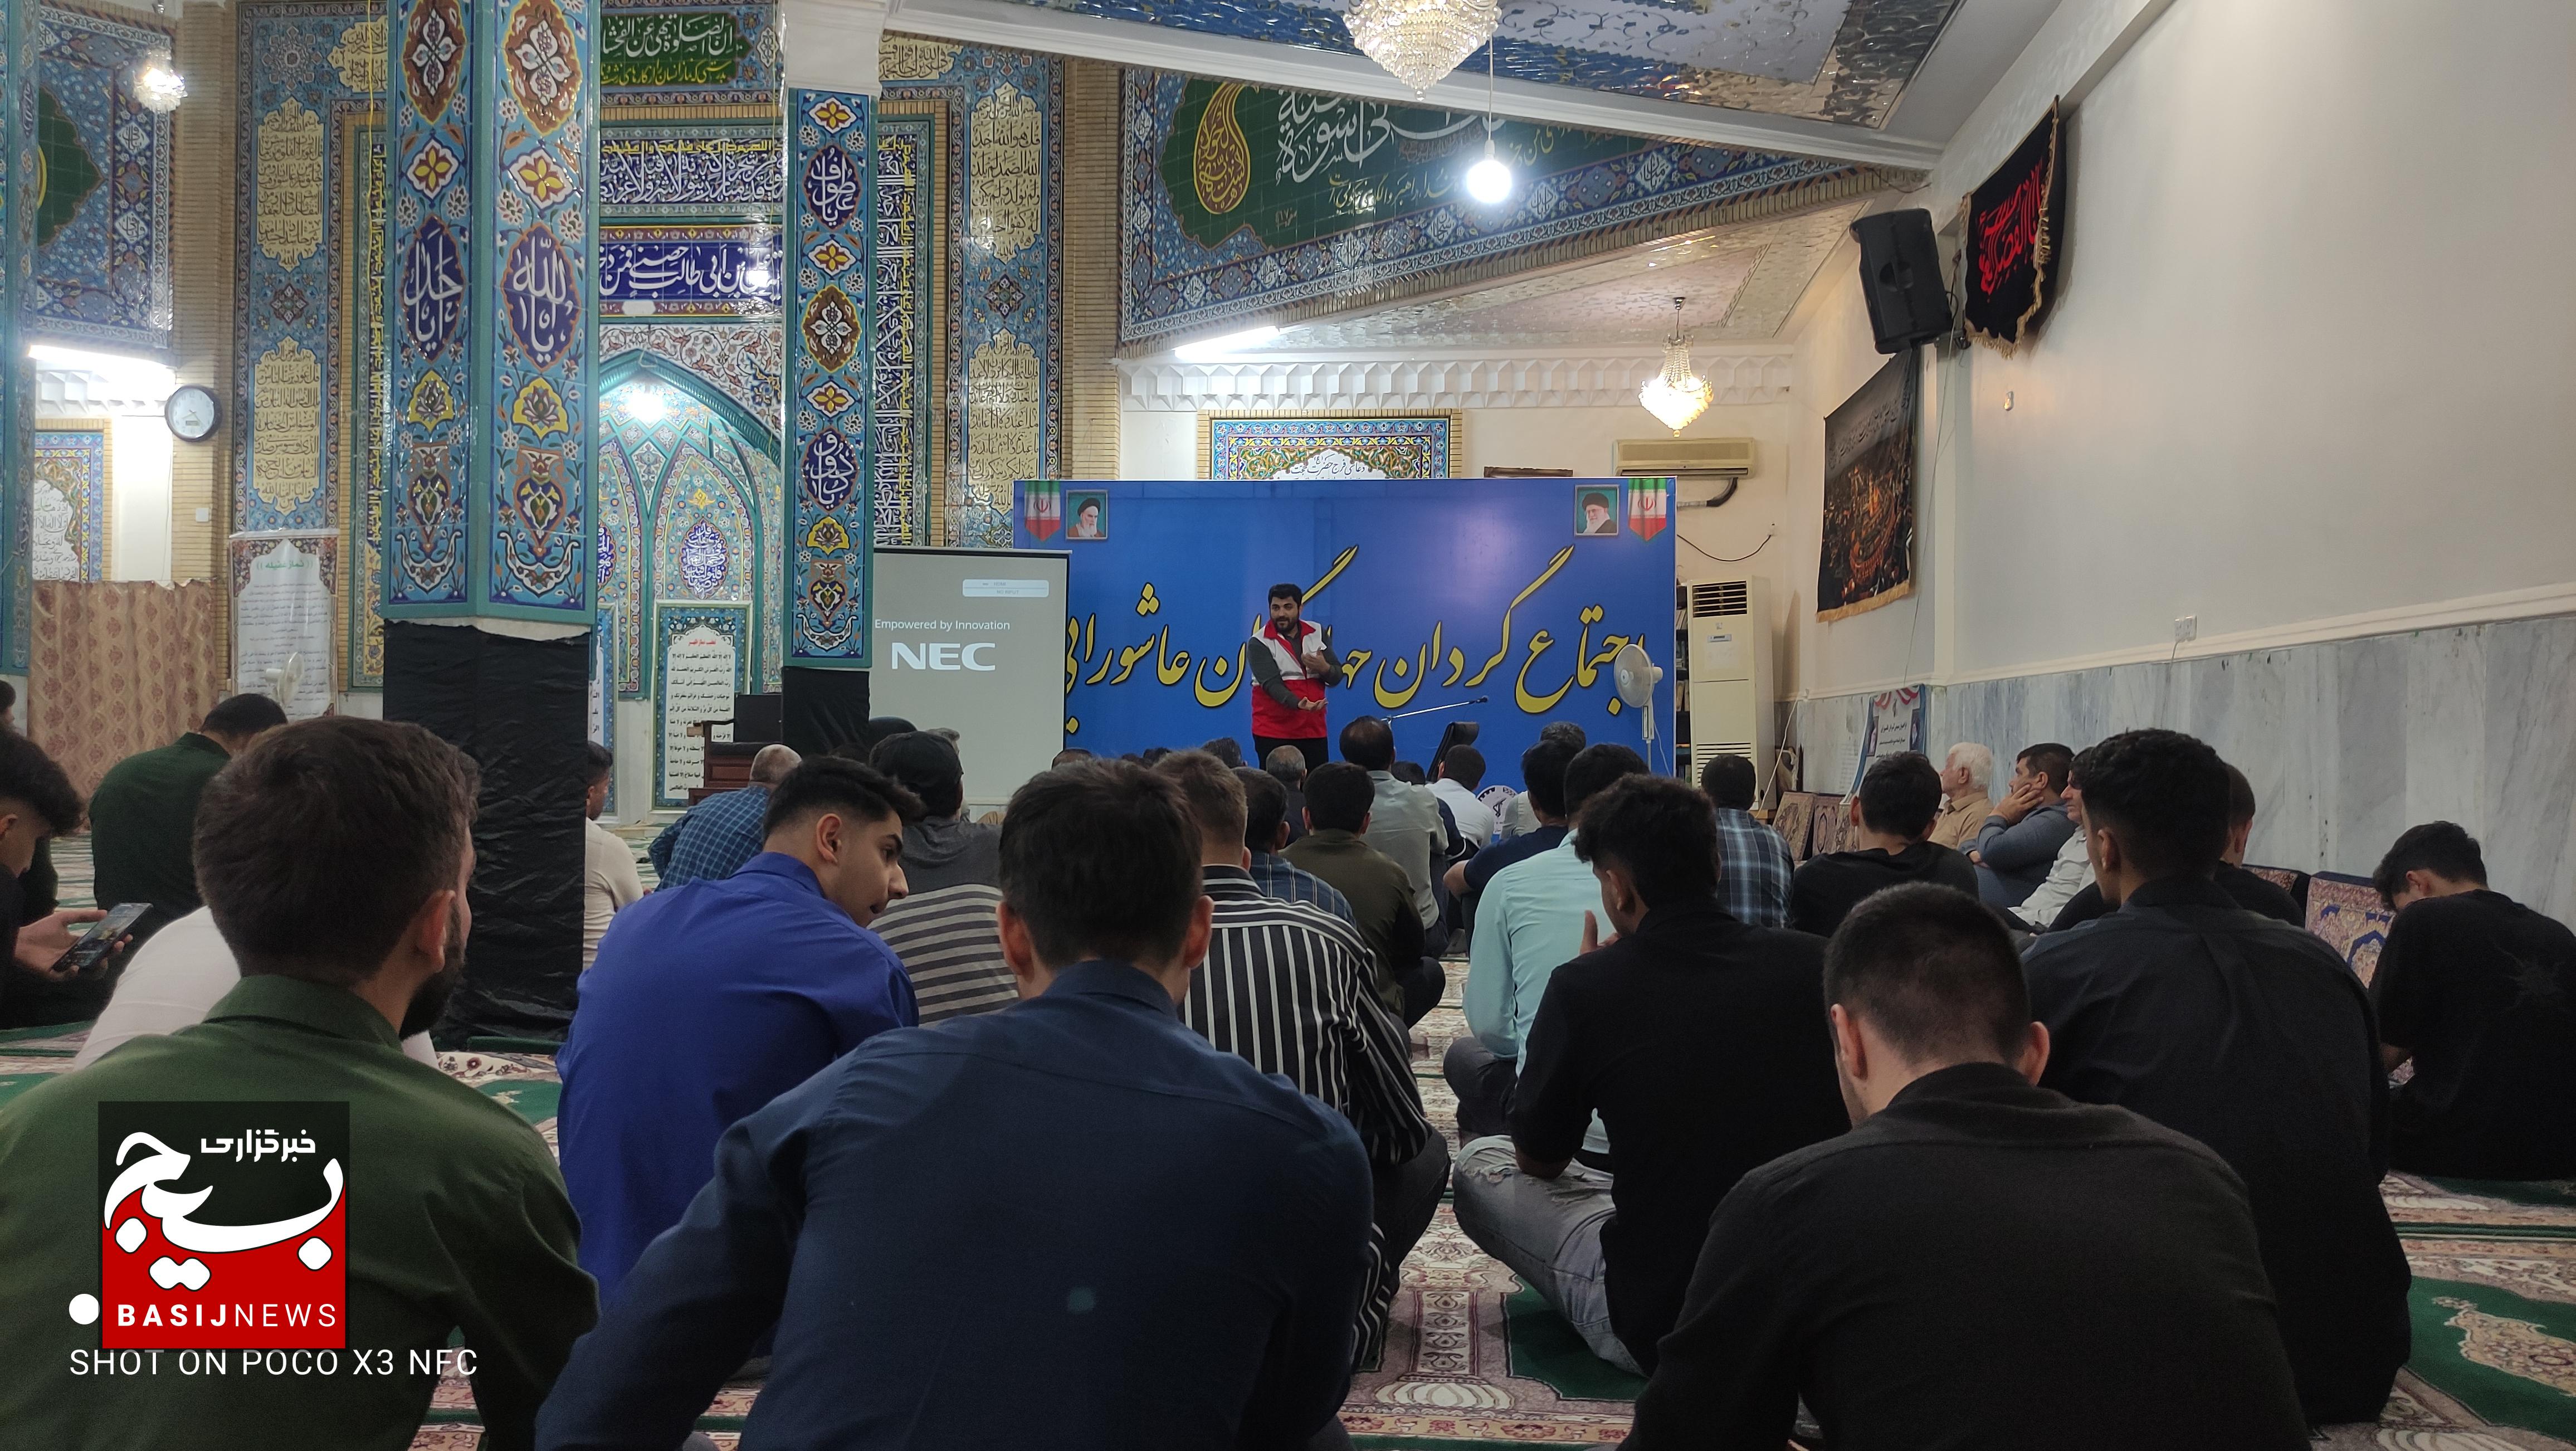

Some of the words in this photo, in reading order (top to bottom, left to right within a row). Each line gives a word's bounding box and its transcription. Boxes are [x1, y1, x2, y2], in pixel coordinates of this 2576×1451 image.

[875, 619, 937, 632] Empowered
[940, 619, 953, 632] by
[955, 620, 1011, 631] Innovation
[1373, 544, 1575, 709] گردان
[891, 642, 996, 671] NEC
